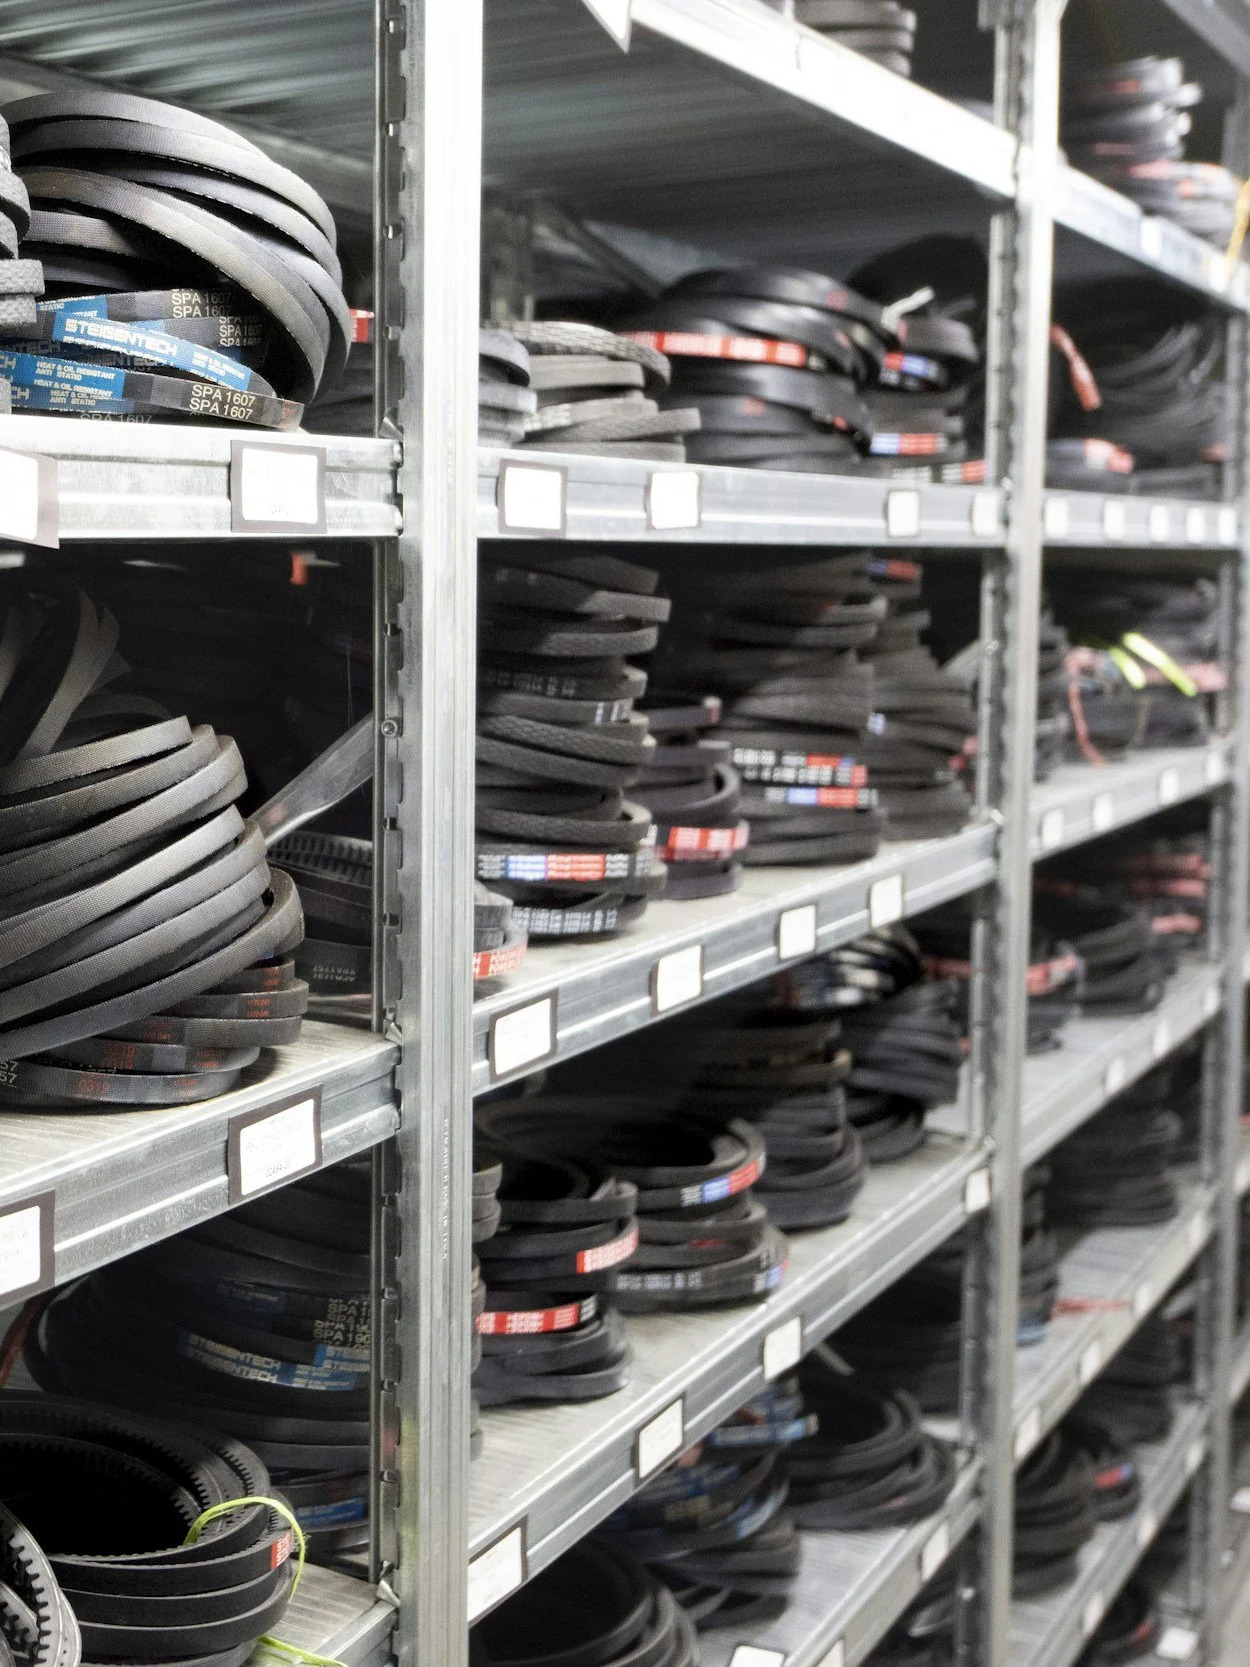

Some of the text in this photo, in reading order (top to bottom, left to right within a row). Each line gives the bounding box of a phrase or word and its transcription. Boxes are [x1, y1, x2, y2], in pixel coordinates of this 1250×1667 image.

[171, 292, 201, 306] SPA
[172, 306, 202, 319] SPA
[65, 318, 178, 357] STEIGENTECH
[219, 325, 241, 338] SPA
[37, 361, 56, 371] HEAT
[56, 371, 83, 381] STATIC
[192, 384, 256, 407] SPA 1607
[189, 398, 253, 420] SPA 1607
